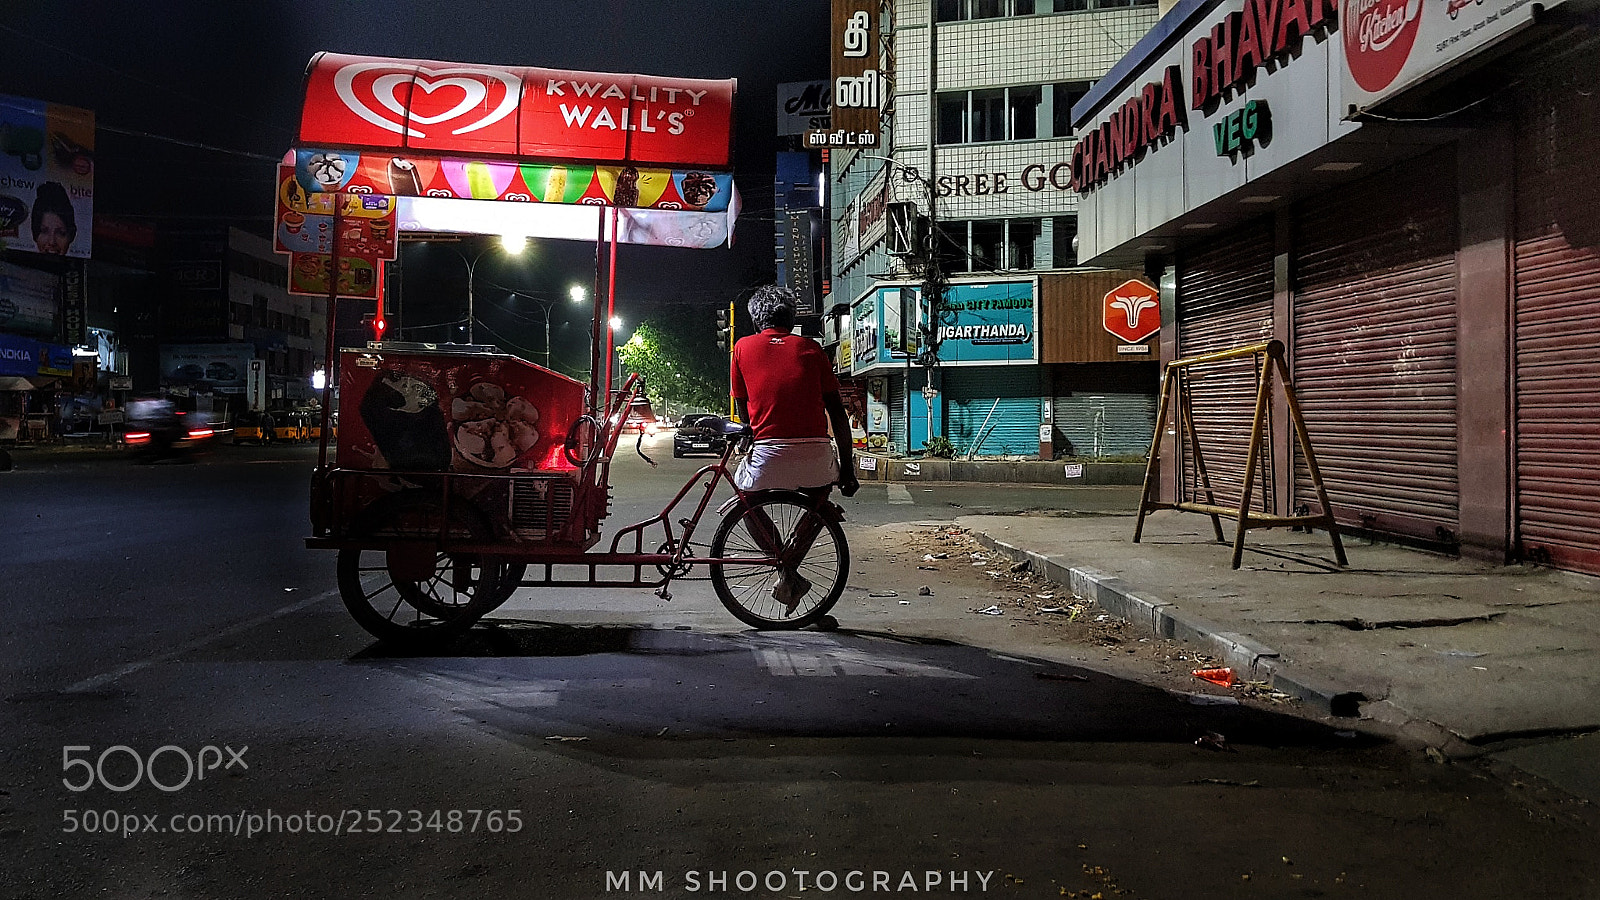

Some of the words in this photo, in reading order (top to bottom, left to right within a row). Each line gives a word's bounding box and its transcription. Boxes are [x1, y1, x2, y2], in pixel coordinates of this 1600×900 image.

[1360, 4, 1405, 52] Kitchen
[546, 79, 708, 106] KWALITY
[559, 103, 685, 135] WALL'S
[1071, 66, 1180, 193] CHANDRA
[1213, 100, 1258, 156] VEG
[0, 176, 35, 190] chew
[70, 185, 92, 198] bite
[936, 172, 1009, 198] SREE
[1021, 162, 1073, 192] GO
[790, 215, 801, 264] MIDNIGHT
[793, 267, 803, 303] MASALA
[966, 299, 989, 311] CITY
[990, 298, 1033, 310] FAMOUS
[936, 323, 1027, 344] JIGARTHANDA
[0, 348, 31, 361] NOKIA
